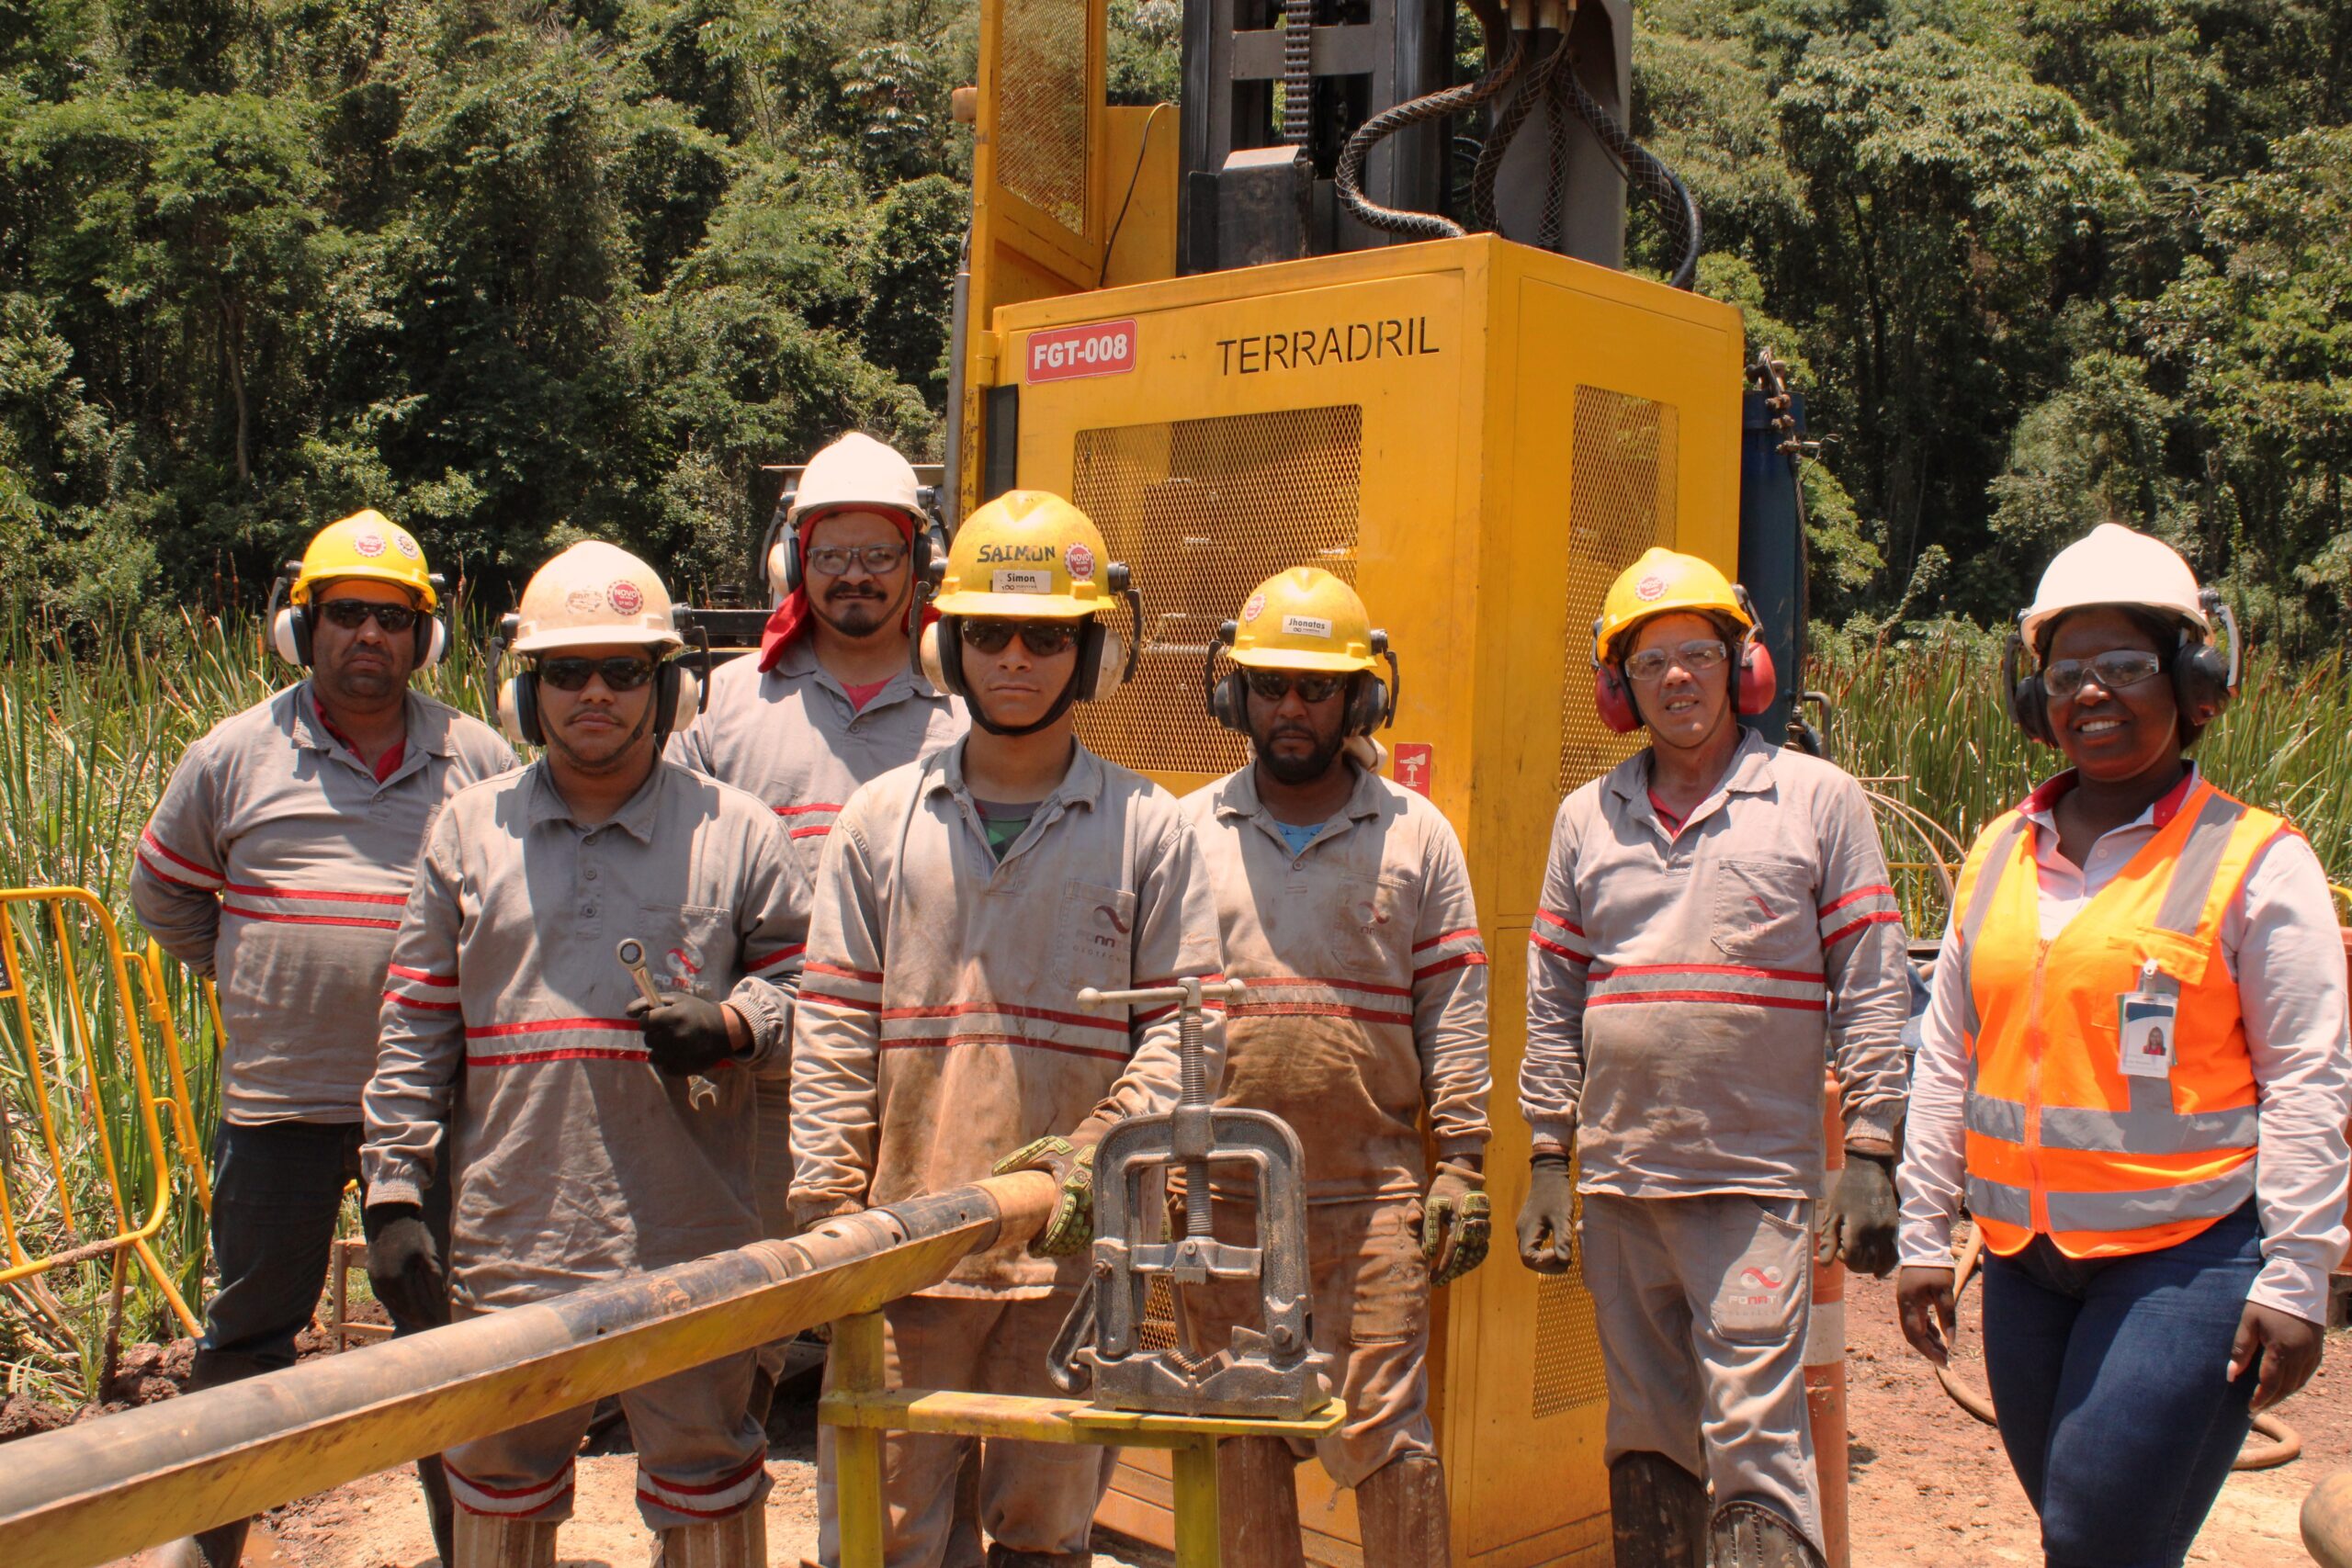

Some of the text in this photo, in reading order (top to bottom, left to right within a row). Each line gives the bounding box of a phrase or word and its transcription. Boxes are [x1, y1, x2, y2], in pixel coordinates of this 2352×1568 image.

[1033, 333, 1128, 371] FGT-008
[1216, 317, 1441, 377] TERRADRIL
[1007, 572, 1035, 582] Simon
[1288, 618, 1326, 629] Jhonatas
